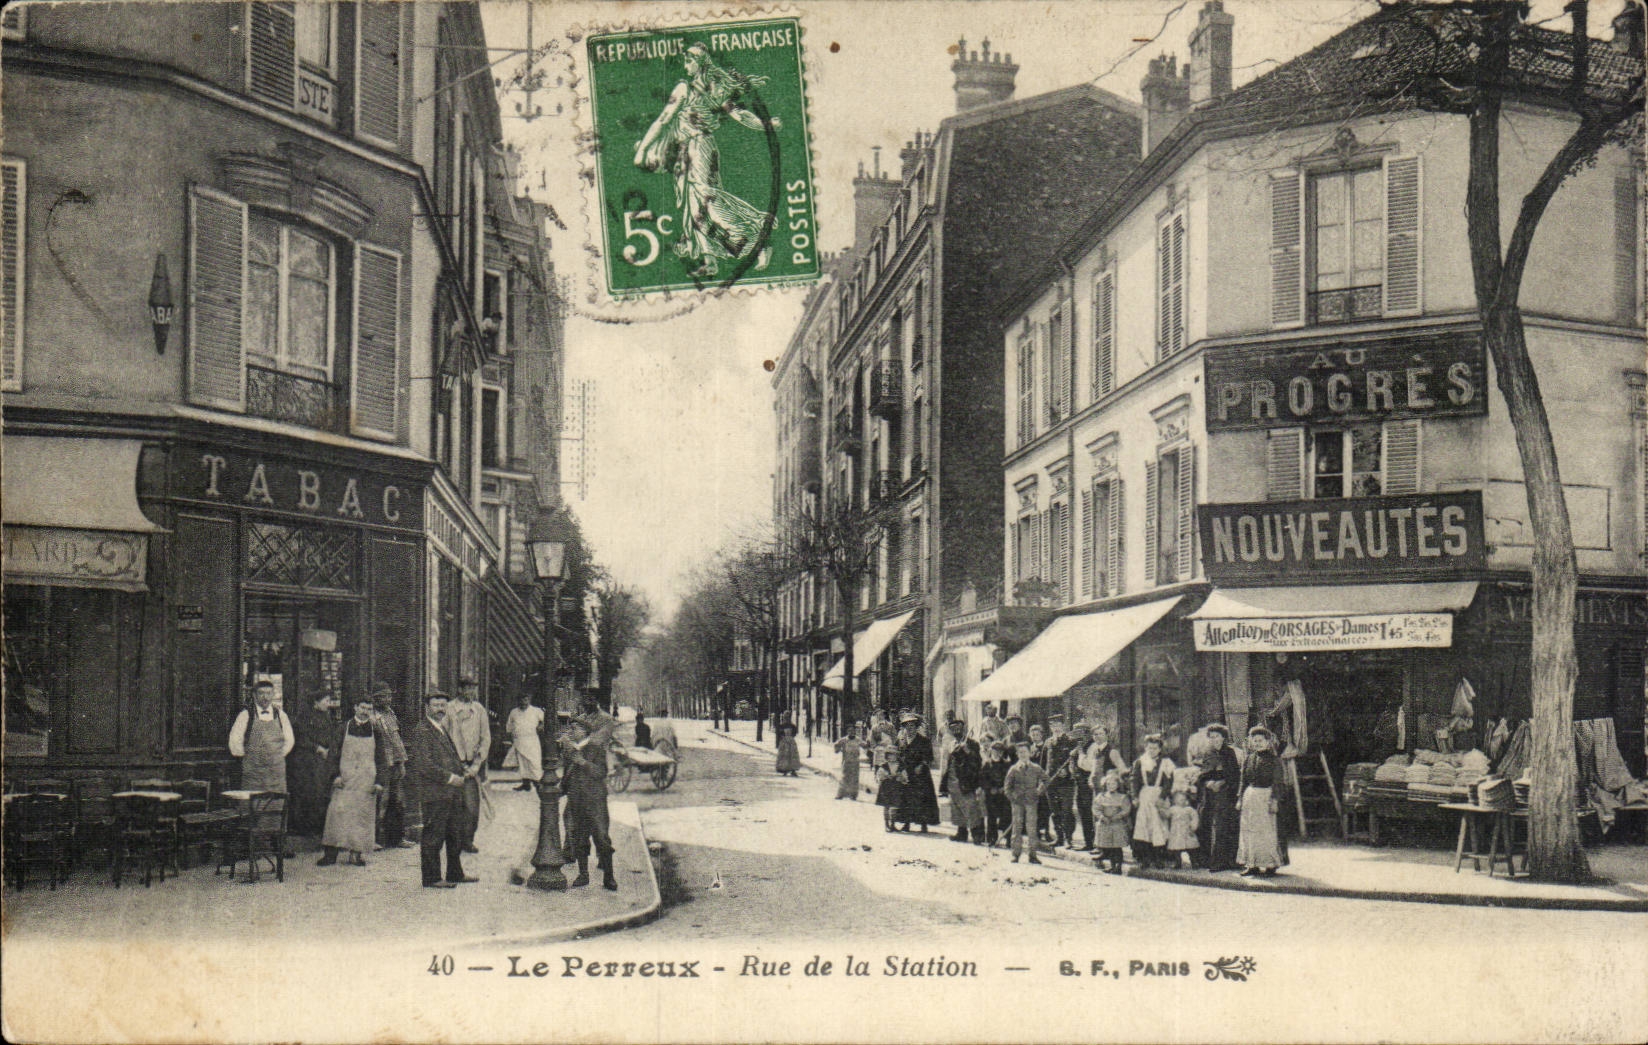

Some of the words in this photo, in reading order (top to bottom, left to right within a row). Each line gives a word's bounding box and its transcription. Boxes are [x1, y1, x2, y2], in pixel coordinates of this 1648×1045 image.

[711, 28, 793, 51] FRANÇAISE
[299, 75, 329, 114] STE
[786, 179, 812, 264] POSTES
[1310, 349, 1367, 369] AU
[1217, 355, 1474, 421] PROGRÈS
[203, 455, 400, 522] TABAC
[1212, 502, 1467, 563] NOUVEAUTÉS
[1270, 621, 1336, 640] CORSAGES
[1342, 619, 1379, 636] Dames
